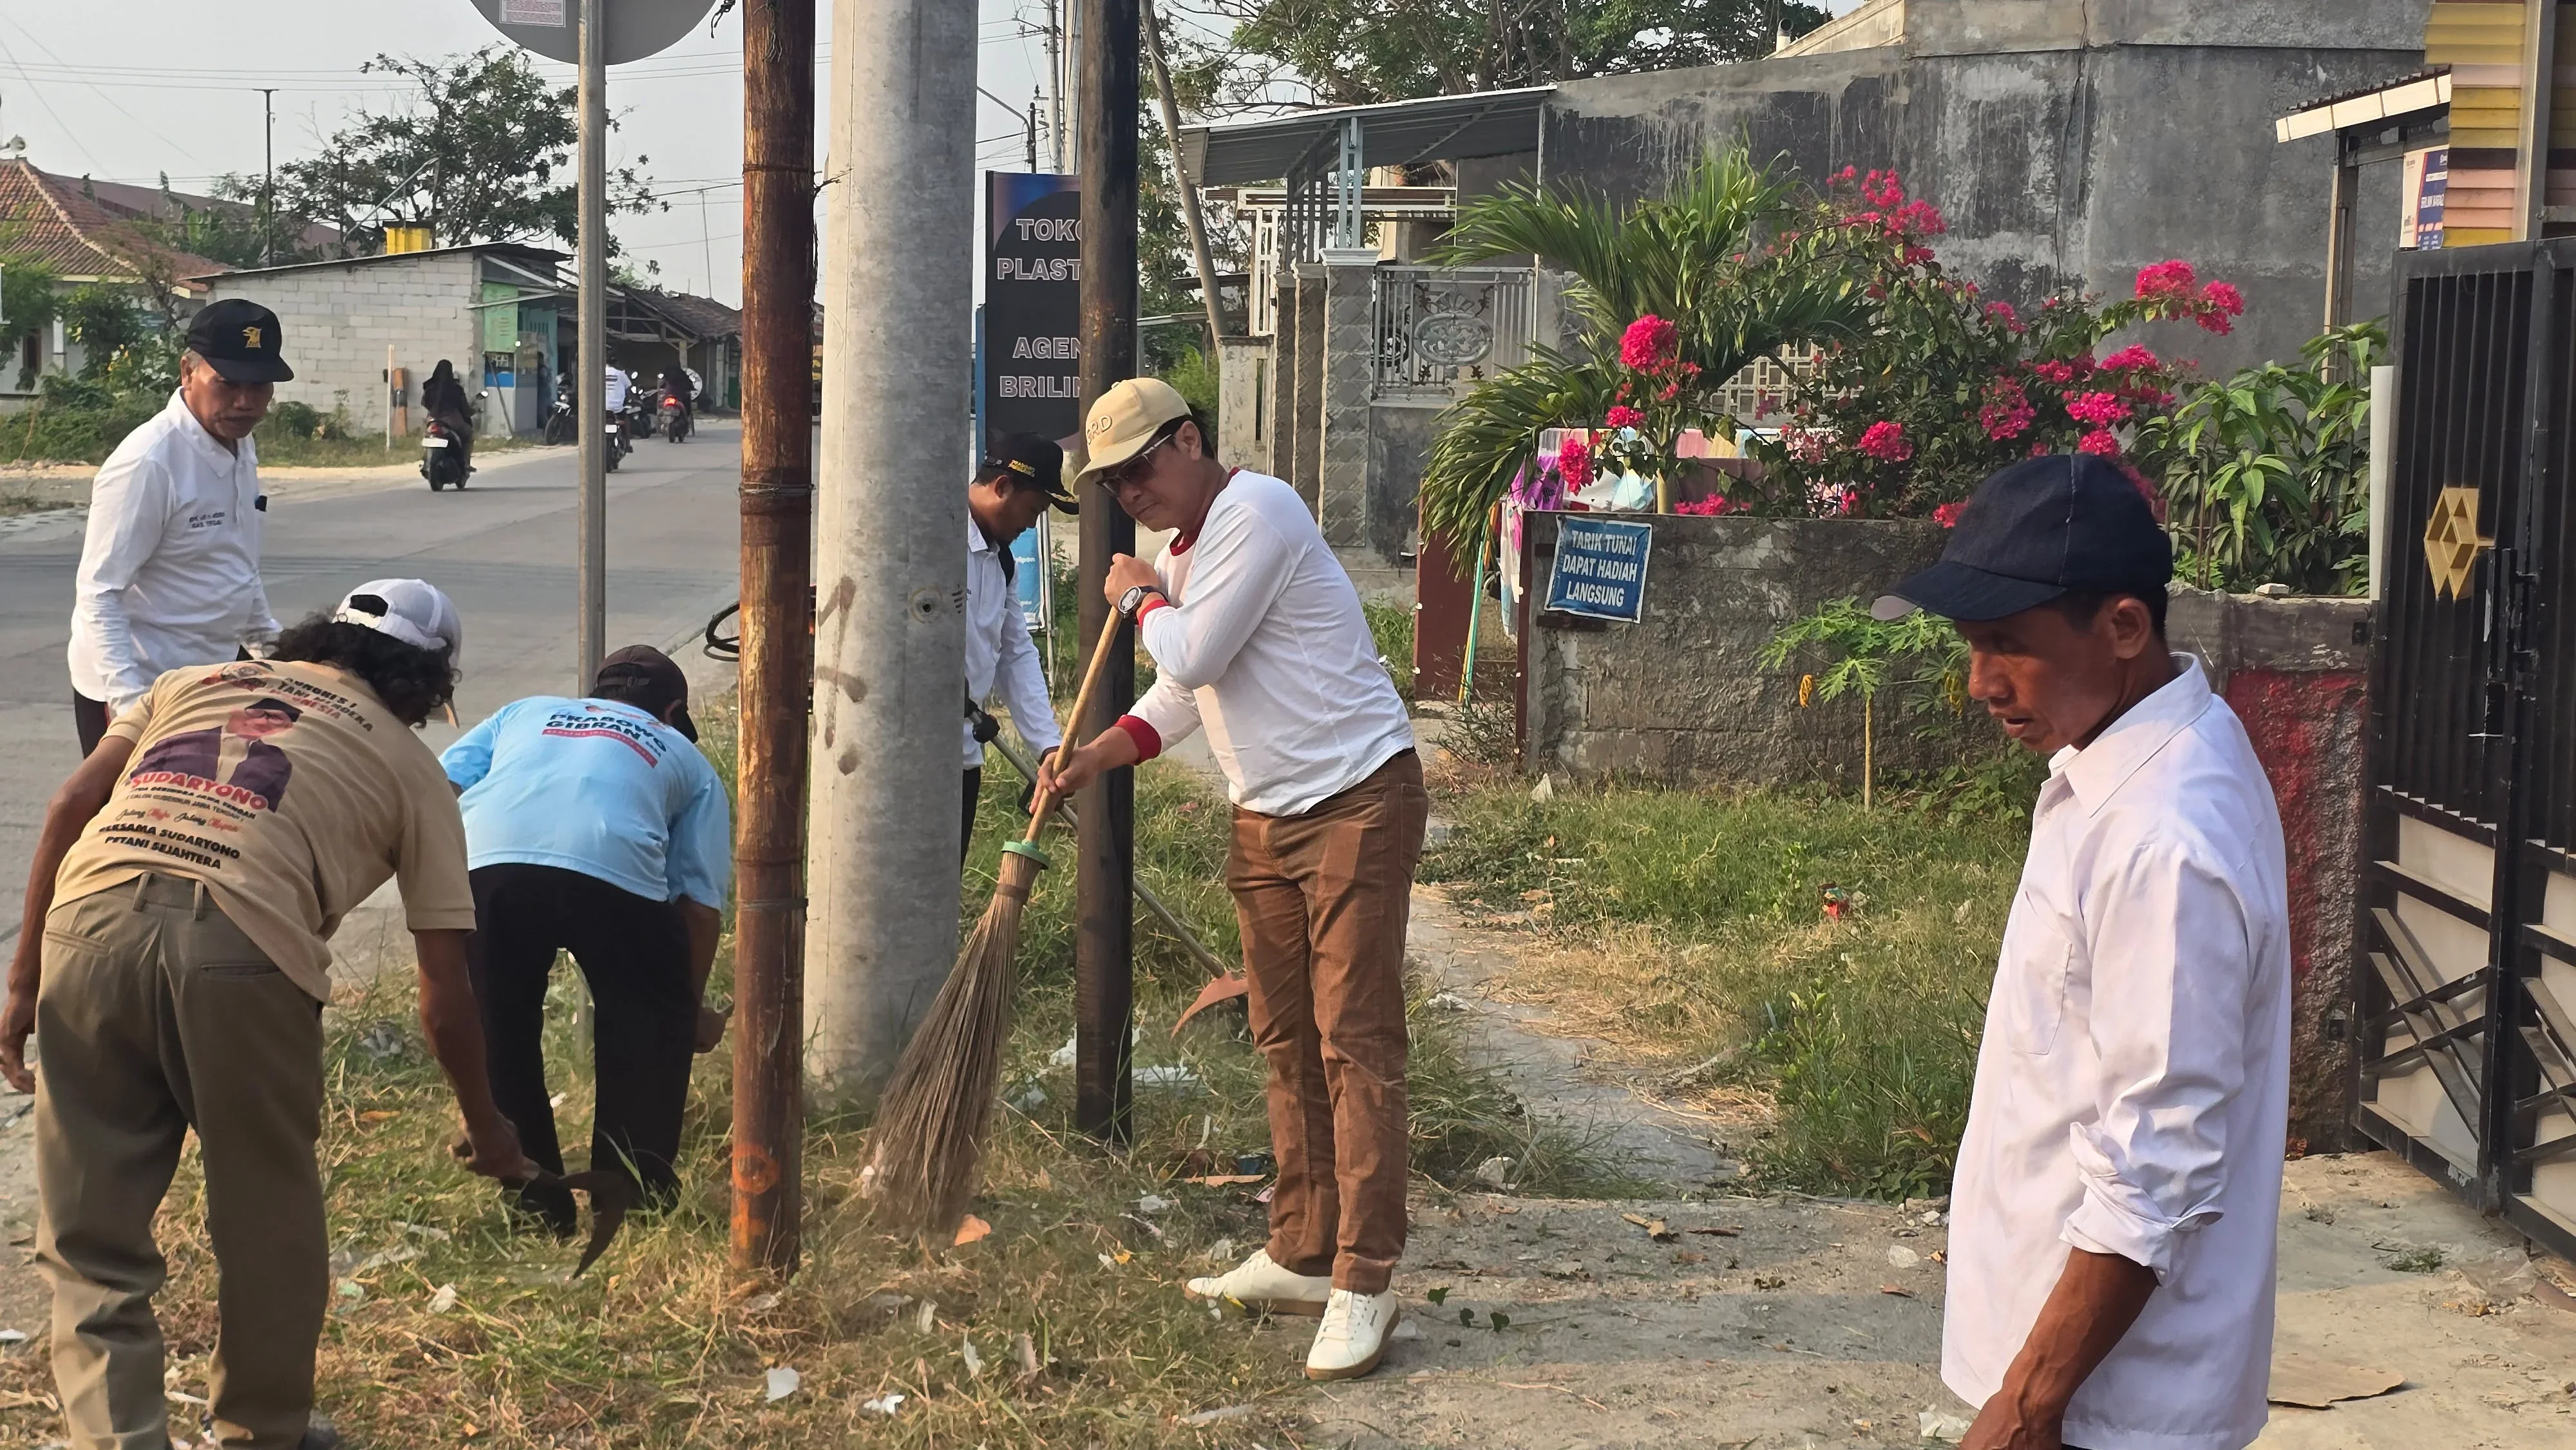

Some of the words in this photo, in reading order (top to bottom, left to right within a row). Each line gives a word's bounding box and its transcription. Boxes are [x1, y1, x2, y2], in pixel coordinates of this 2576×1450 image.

[1016, 218, 1081, 241] TOK
[1571, 530, 1603, 551] TARIK
[1605, 534, 1638, 556] TUNAI
[1562, 554, 1596, 577] DAPAT
[1596, 559, 1638, 583] HADIAH
[1566, 581, 1625, 607] LANGSUNG
[545, 720, 642, 741] GIBRAN
[549, 714, 667, 752] PRABOWO
[131, 772, 269, 811] SUDARYONO
[150, 841, 221, 870] SEJAHTERA
[158, 828, 240, 860] SUDARYONO
